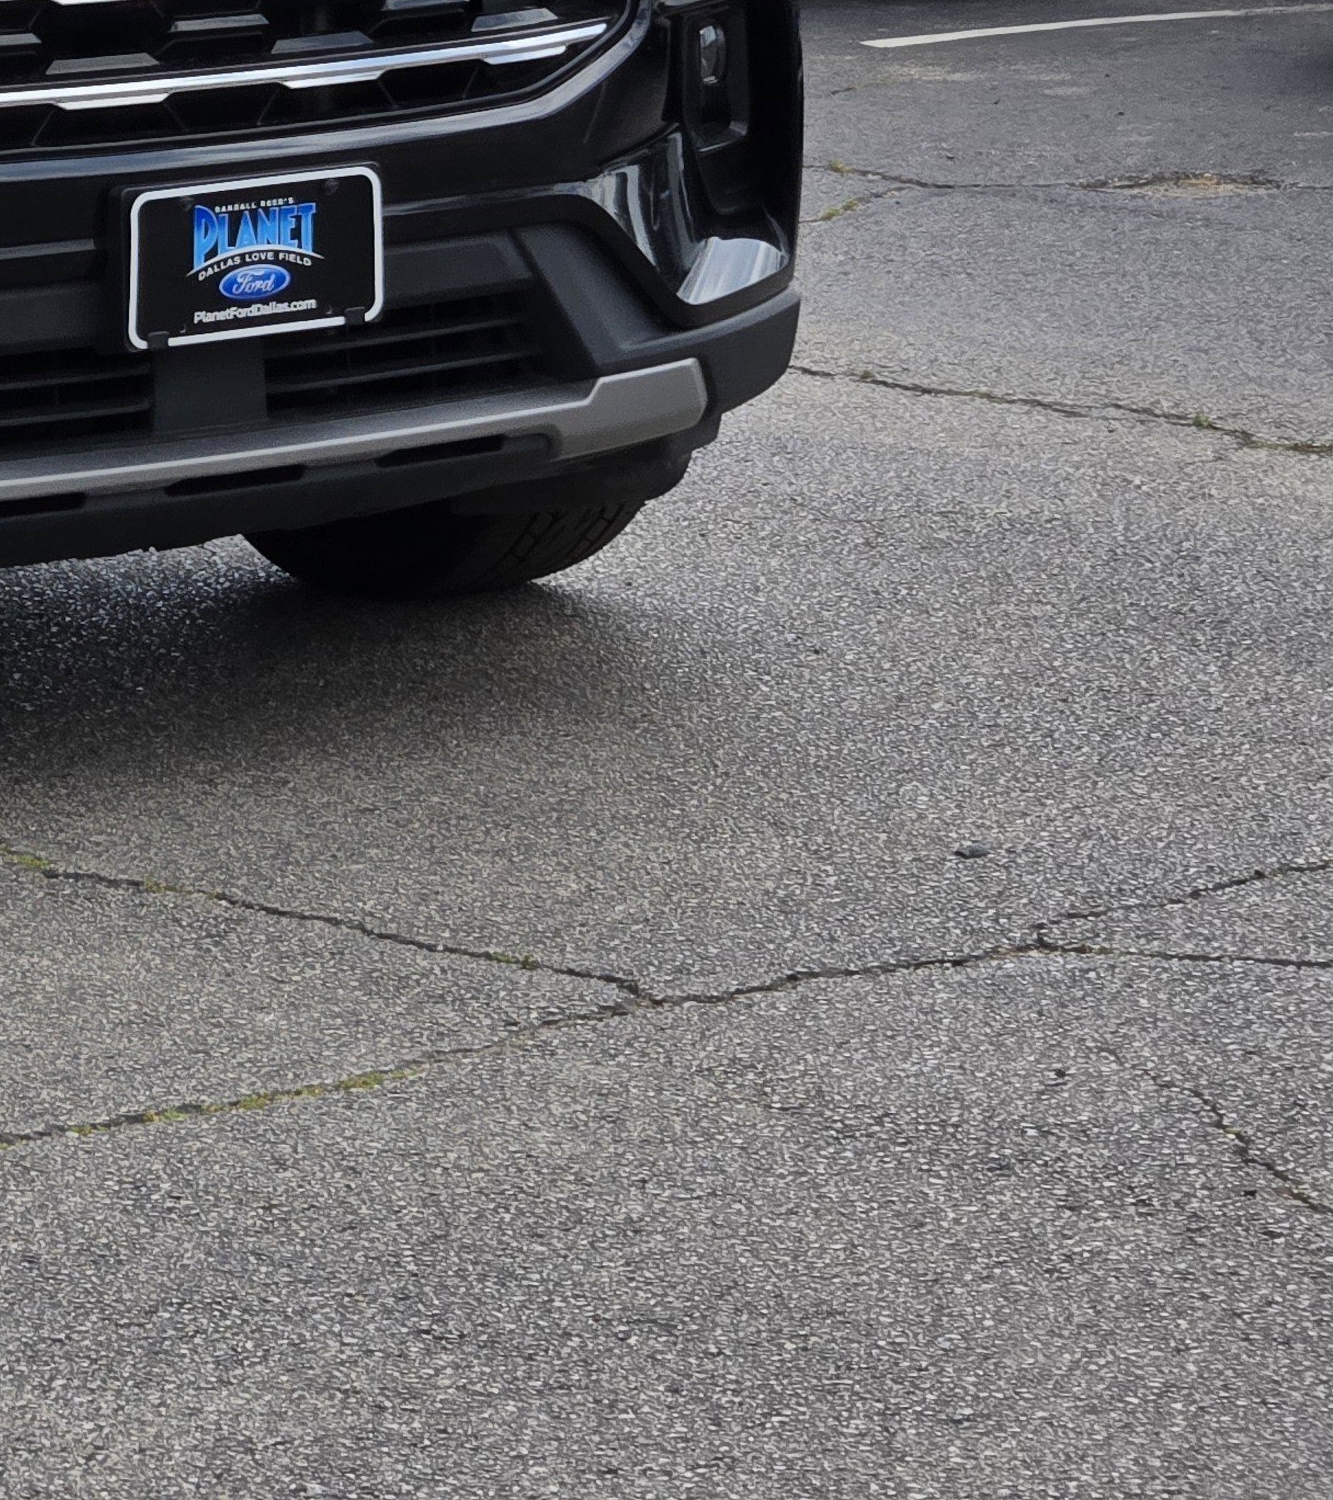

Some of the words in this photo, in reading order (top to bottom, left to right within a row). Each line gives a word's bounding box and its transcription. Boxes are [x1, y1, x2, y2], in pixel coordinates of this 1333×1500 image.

[193, 202, 317, 271] PLANET
[198, 256, 242, 281] DALLAS
[245, 251, 275, 262] LOVE
[278, 252, 313, 267] FIELD
[232, 269, 276, 295] Ford
[193, 298, 318, 324] PlanetFordDallas.com
